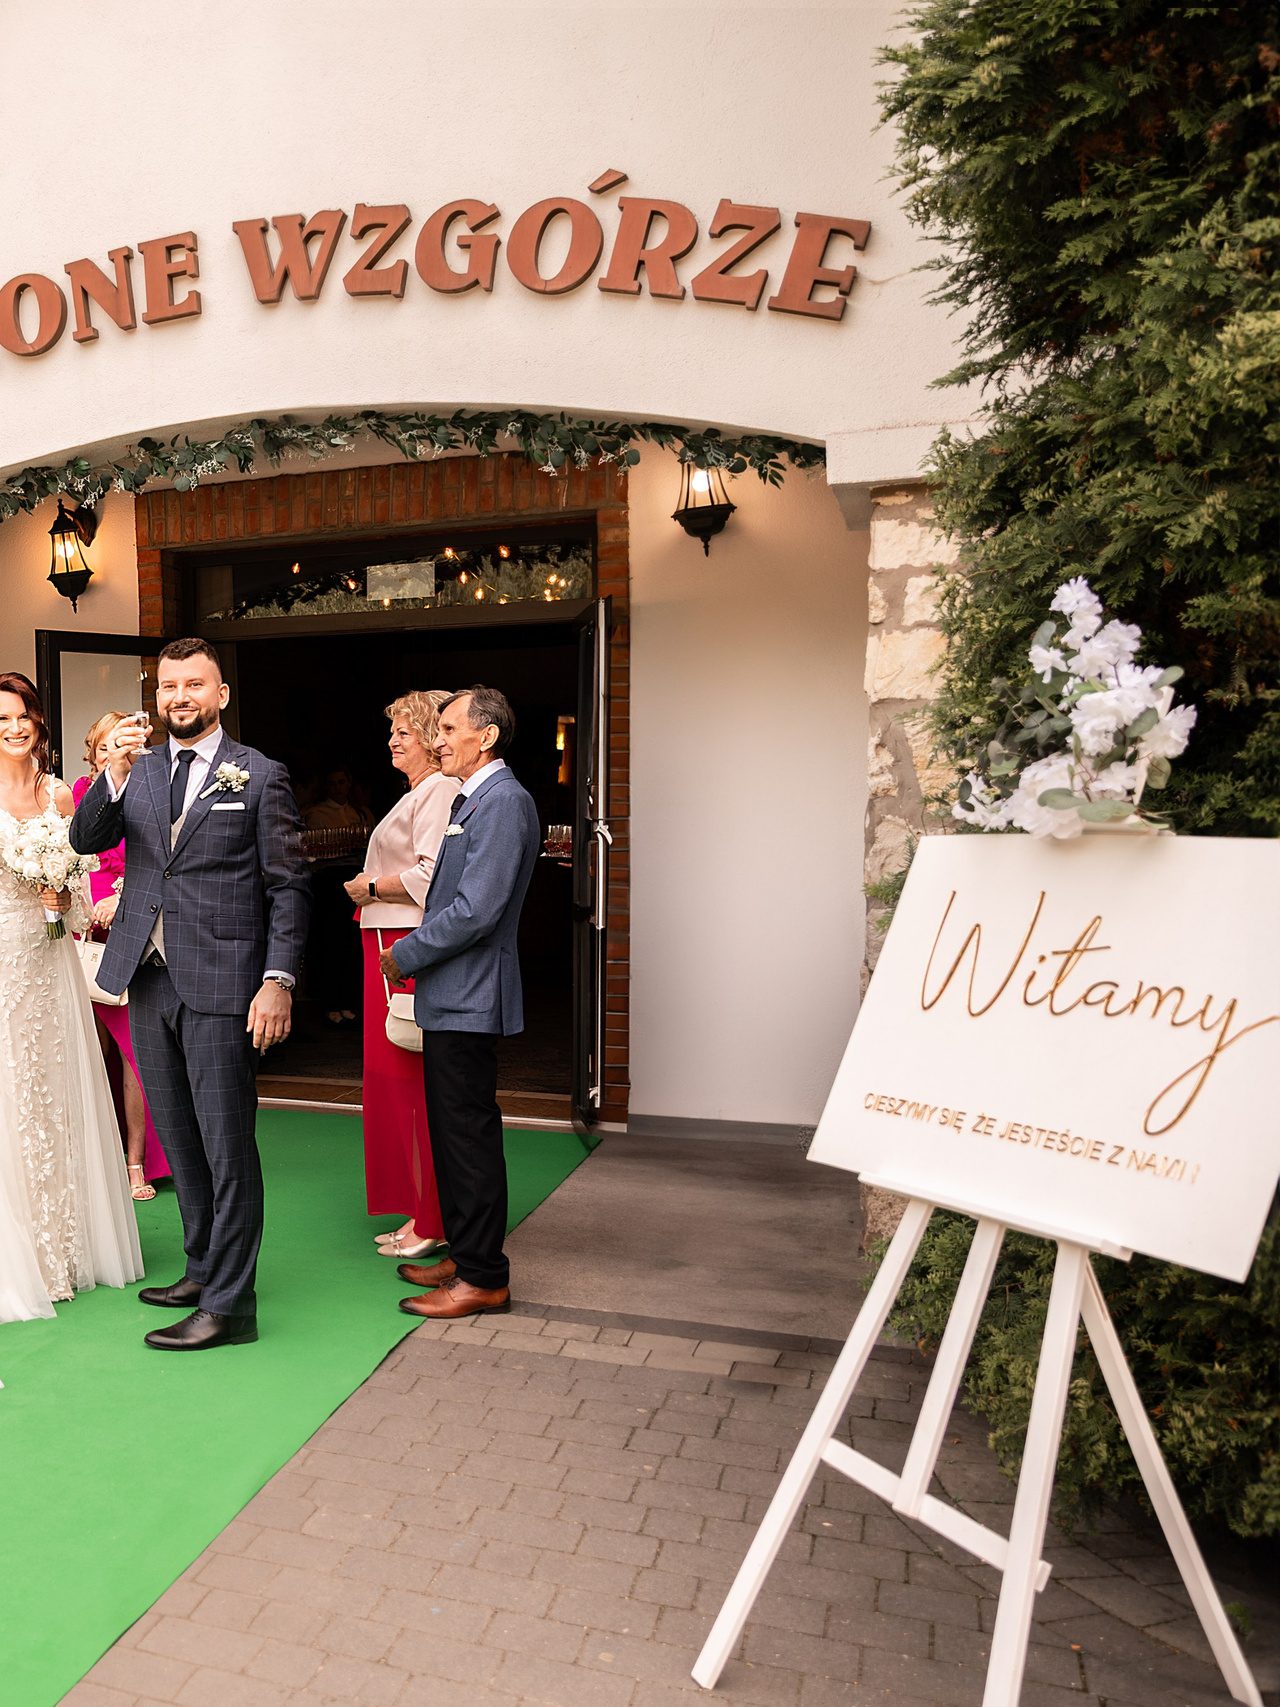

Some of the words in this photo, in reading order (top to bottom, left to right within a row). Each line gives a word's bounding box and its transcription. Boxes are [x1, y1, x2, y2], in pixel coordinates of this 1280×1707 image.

[232, 168, 872, 321] WZGÓRZE
[921, 889, 1280, 1136] Witamy
[863, 1092, 938, 1123] CIESZYMY
[938, 1107, 967, 1134] SIĘ
[971, 1112, 997, 1136] ŻE
[998, 1121, 1106, 1161] JESTEŚCIE
[1107, 1144, 1125, 1166] Z
[1126, 1149, 1187, 1181] NAMI
